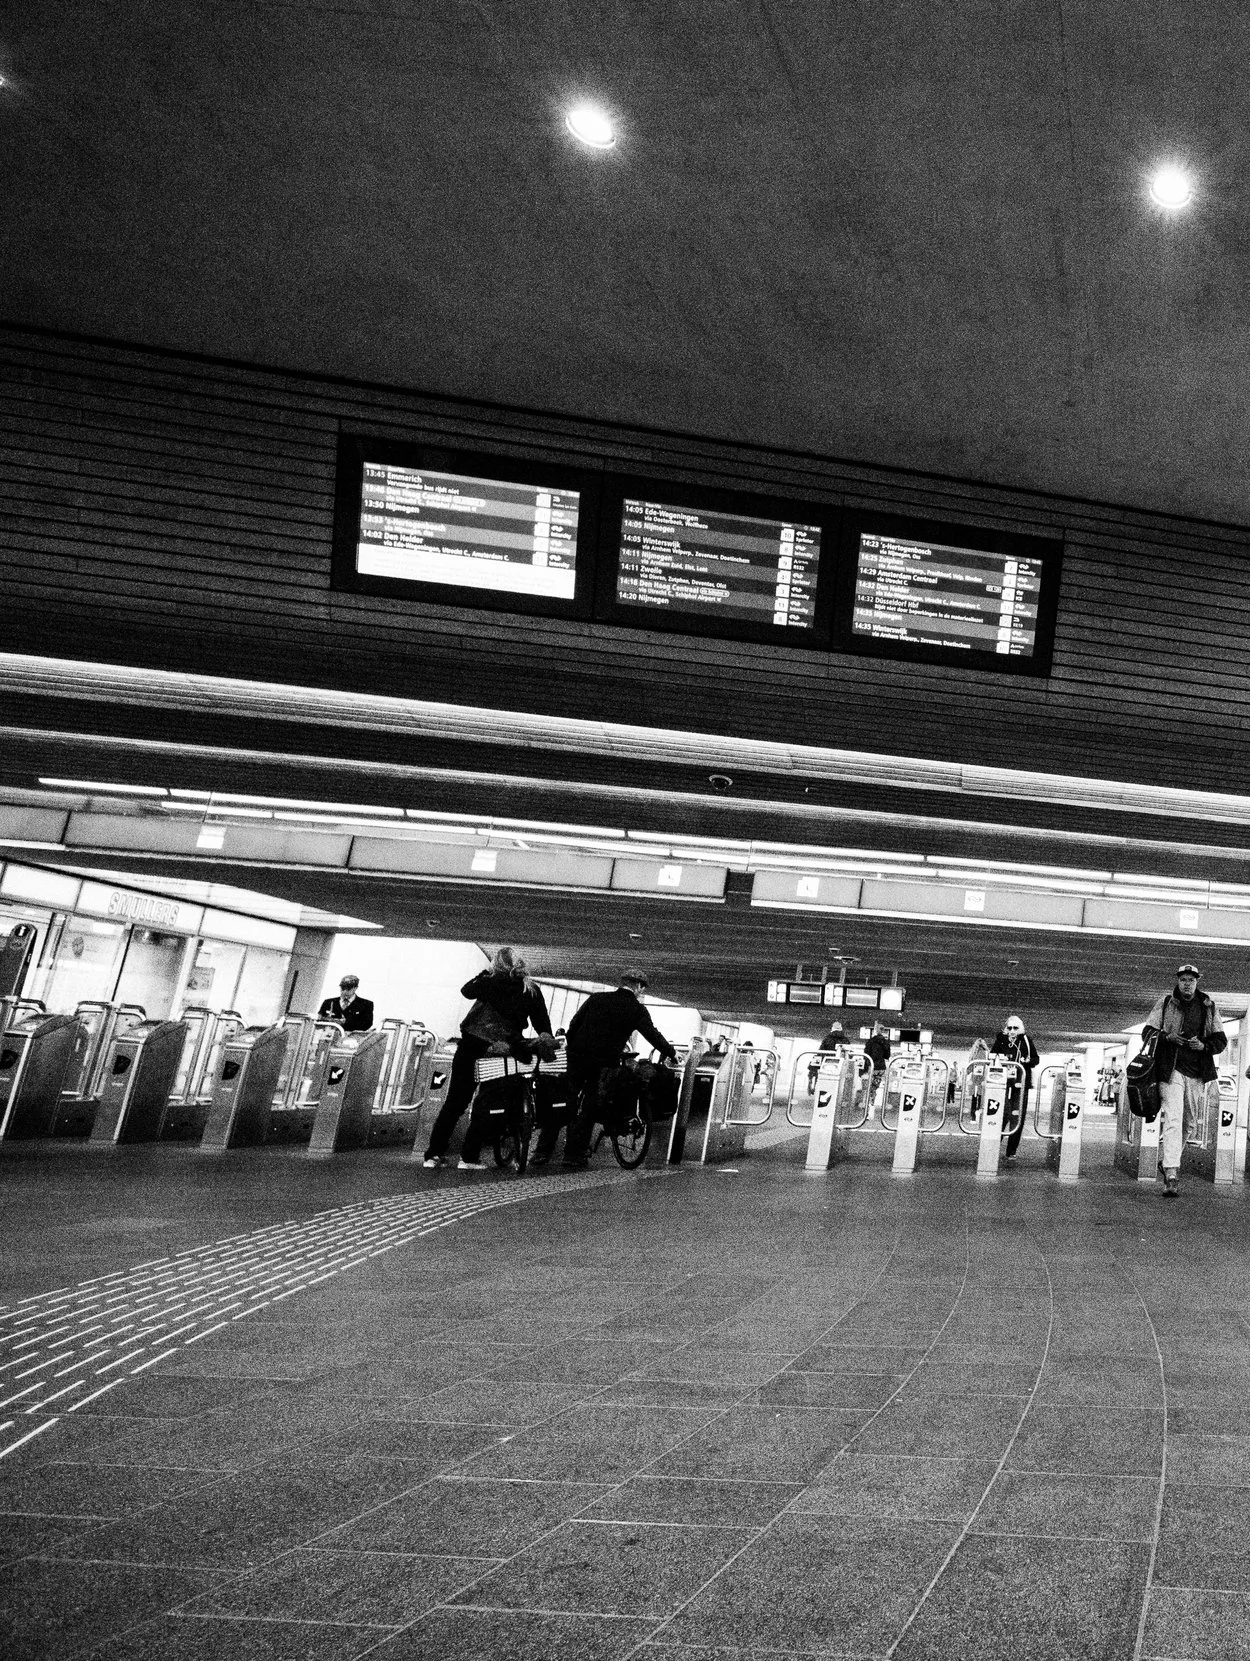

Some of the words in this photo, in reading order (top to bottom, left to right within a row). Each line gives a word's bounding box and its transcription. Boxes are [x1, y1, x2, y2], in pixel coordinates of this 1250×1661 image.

[366, 469, 385, 478] 13:45
[388, 472, 422, 483] Emmerich
[386, 502, 420, 515] Nijmegen
[626, 505, 643, 514] 14:05
[645, 508, 699, 523] Ede-Wageningen
[625, 520, 642, 528] 14:05
[644, 523, 675, 534] Nijmegen
[363, 530, 382, 539] 14:02
[400, 534, 423, 544] Helder
[623, 534, 641, 542] 14:05
[643, 537, 681, 549] Winterswijk
[862, 540, 879, 548] 14:23
[880, 542, 931, 556] 's-Hertogenbosch
[622, 549, 640, 557] 14:11
[641, 551, 673, 563] Nijmegen
[621, 563, 639, 571] 14:11
[641, 565, 662, 574] Zwolle
[878, 570, 911, 580] Amsterdam
[913, 575, 938, 584] Centraal
[654, 582, 671, 591] Haag
[672, 584, 699, 593] Centraal
[890, 585, 910, 594] Helder
[619, 592, 637, 600] 14:20
[638, 594, 669, 605] Nijmegen
[875, 597, 907, 607] Düsseldorf
[873, 624, 907, 636] Winterswijk
[108, 892, 180, 926] SMULLERS
